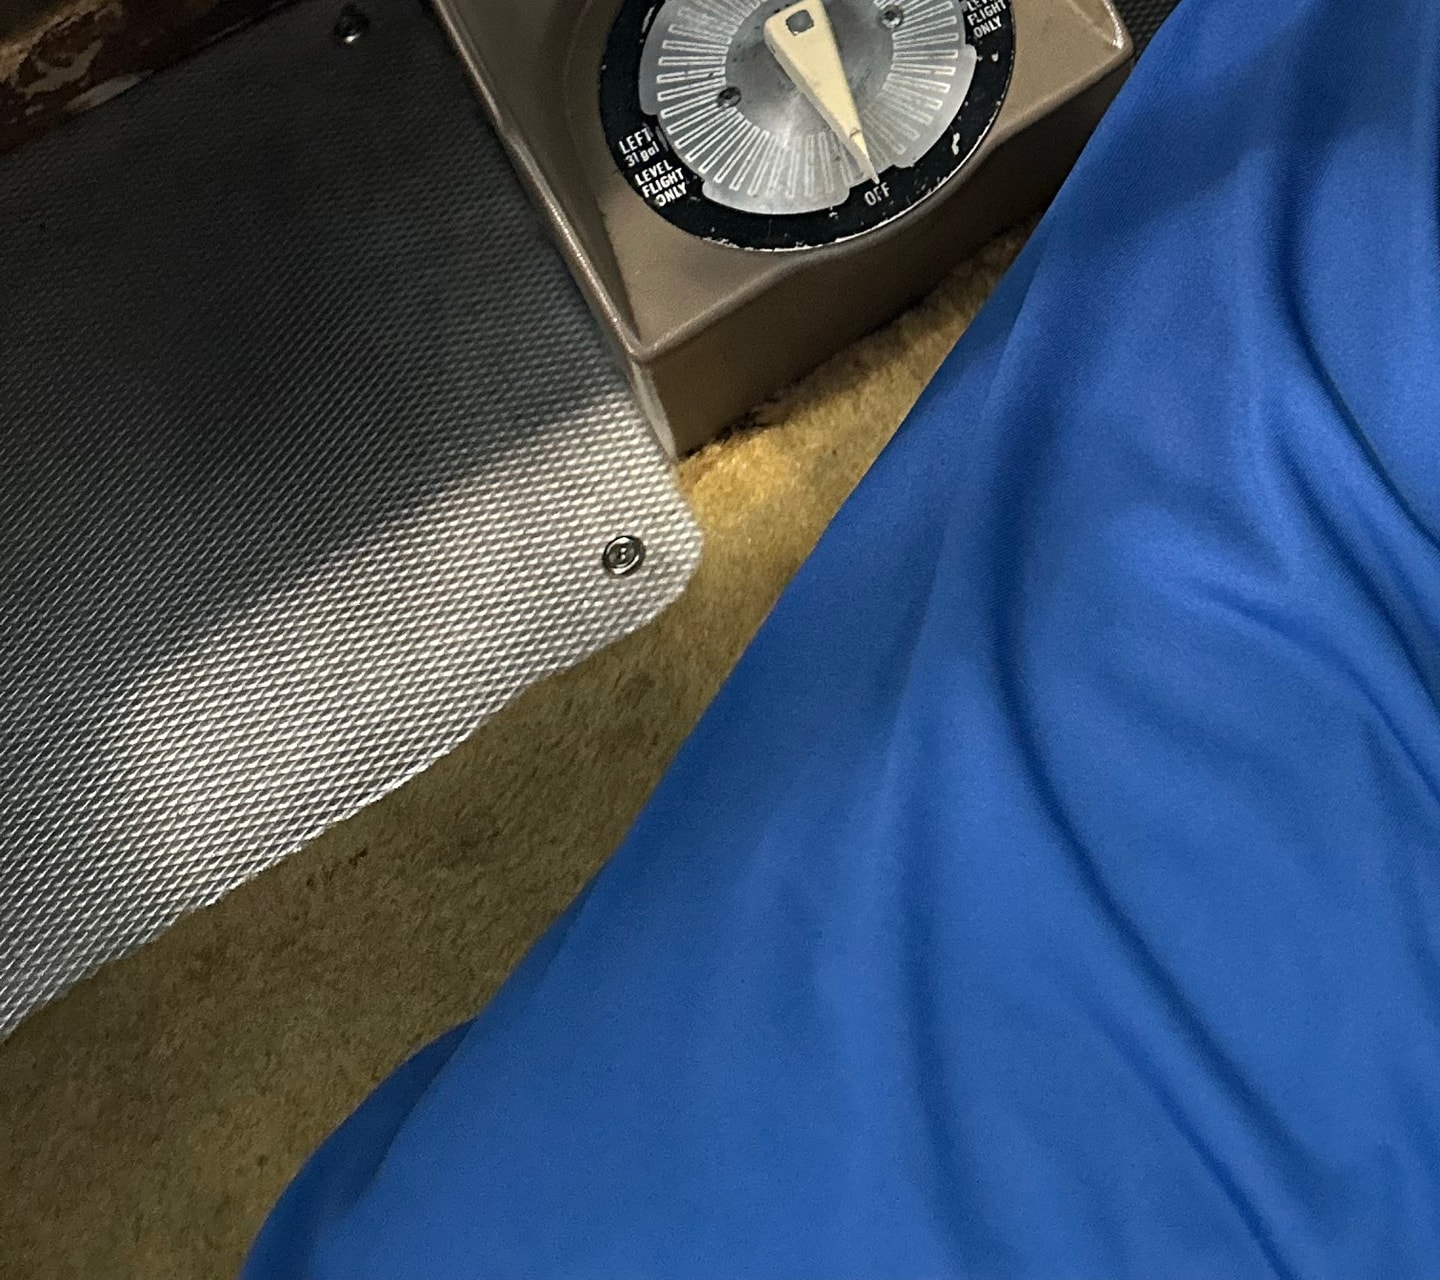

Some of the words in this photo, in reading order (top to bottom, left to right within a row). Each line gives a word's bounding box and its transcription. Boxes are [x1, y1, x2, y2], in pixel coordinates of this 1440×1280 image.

[973, 15, 1003, 38] ONLY
[618, 127, 652, 155] LEFT
[624, 151, 640, 167] 31
[640, 140, 660, 163] gal
[634, 159, 673, 186] LEVEL
[641, 167, 684, 198] FLIGHT
[655, 181, 687, 207] ONLY
[864, 181, 892, 207] OFF
